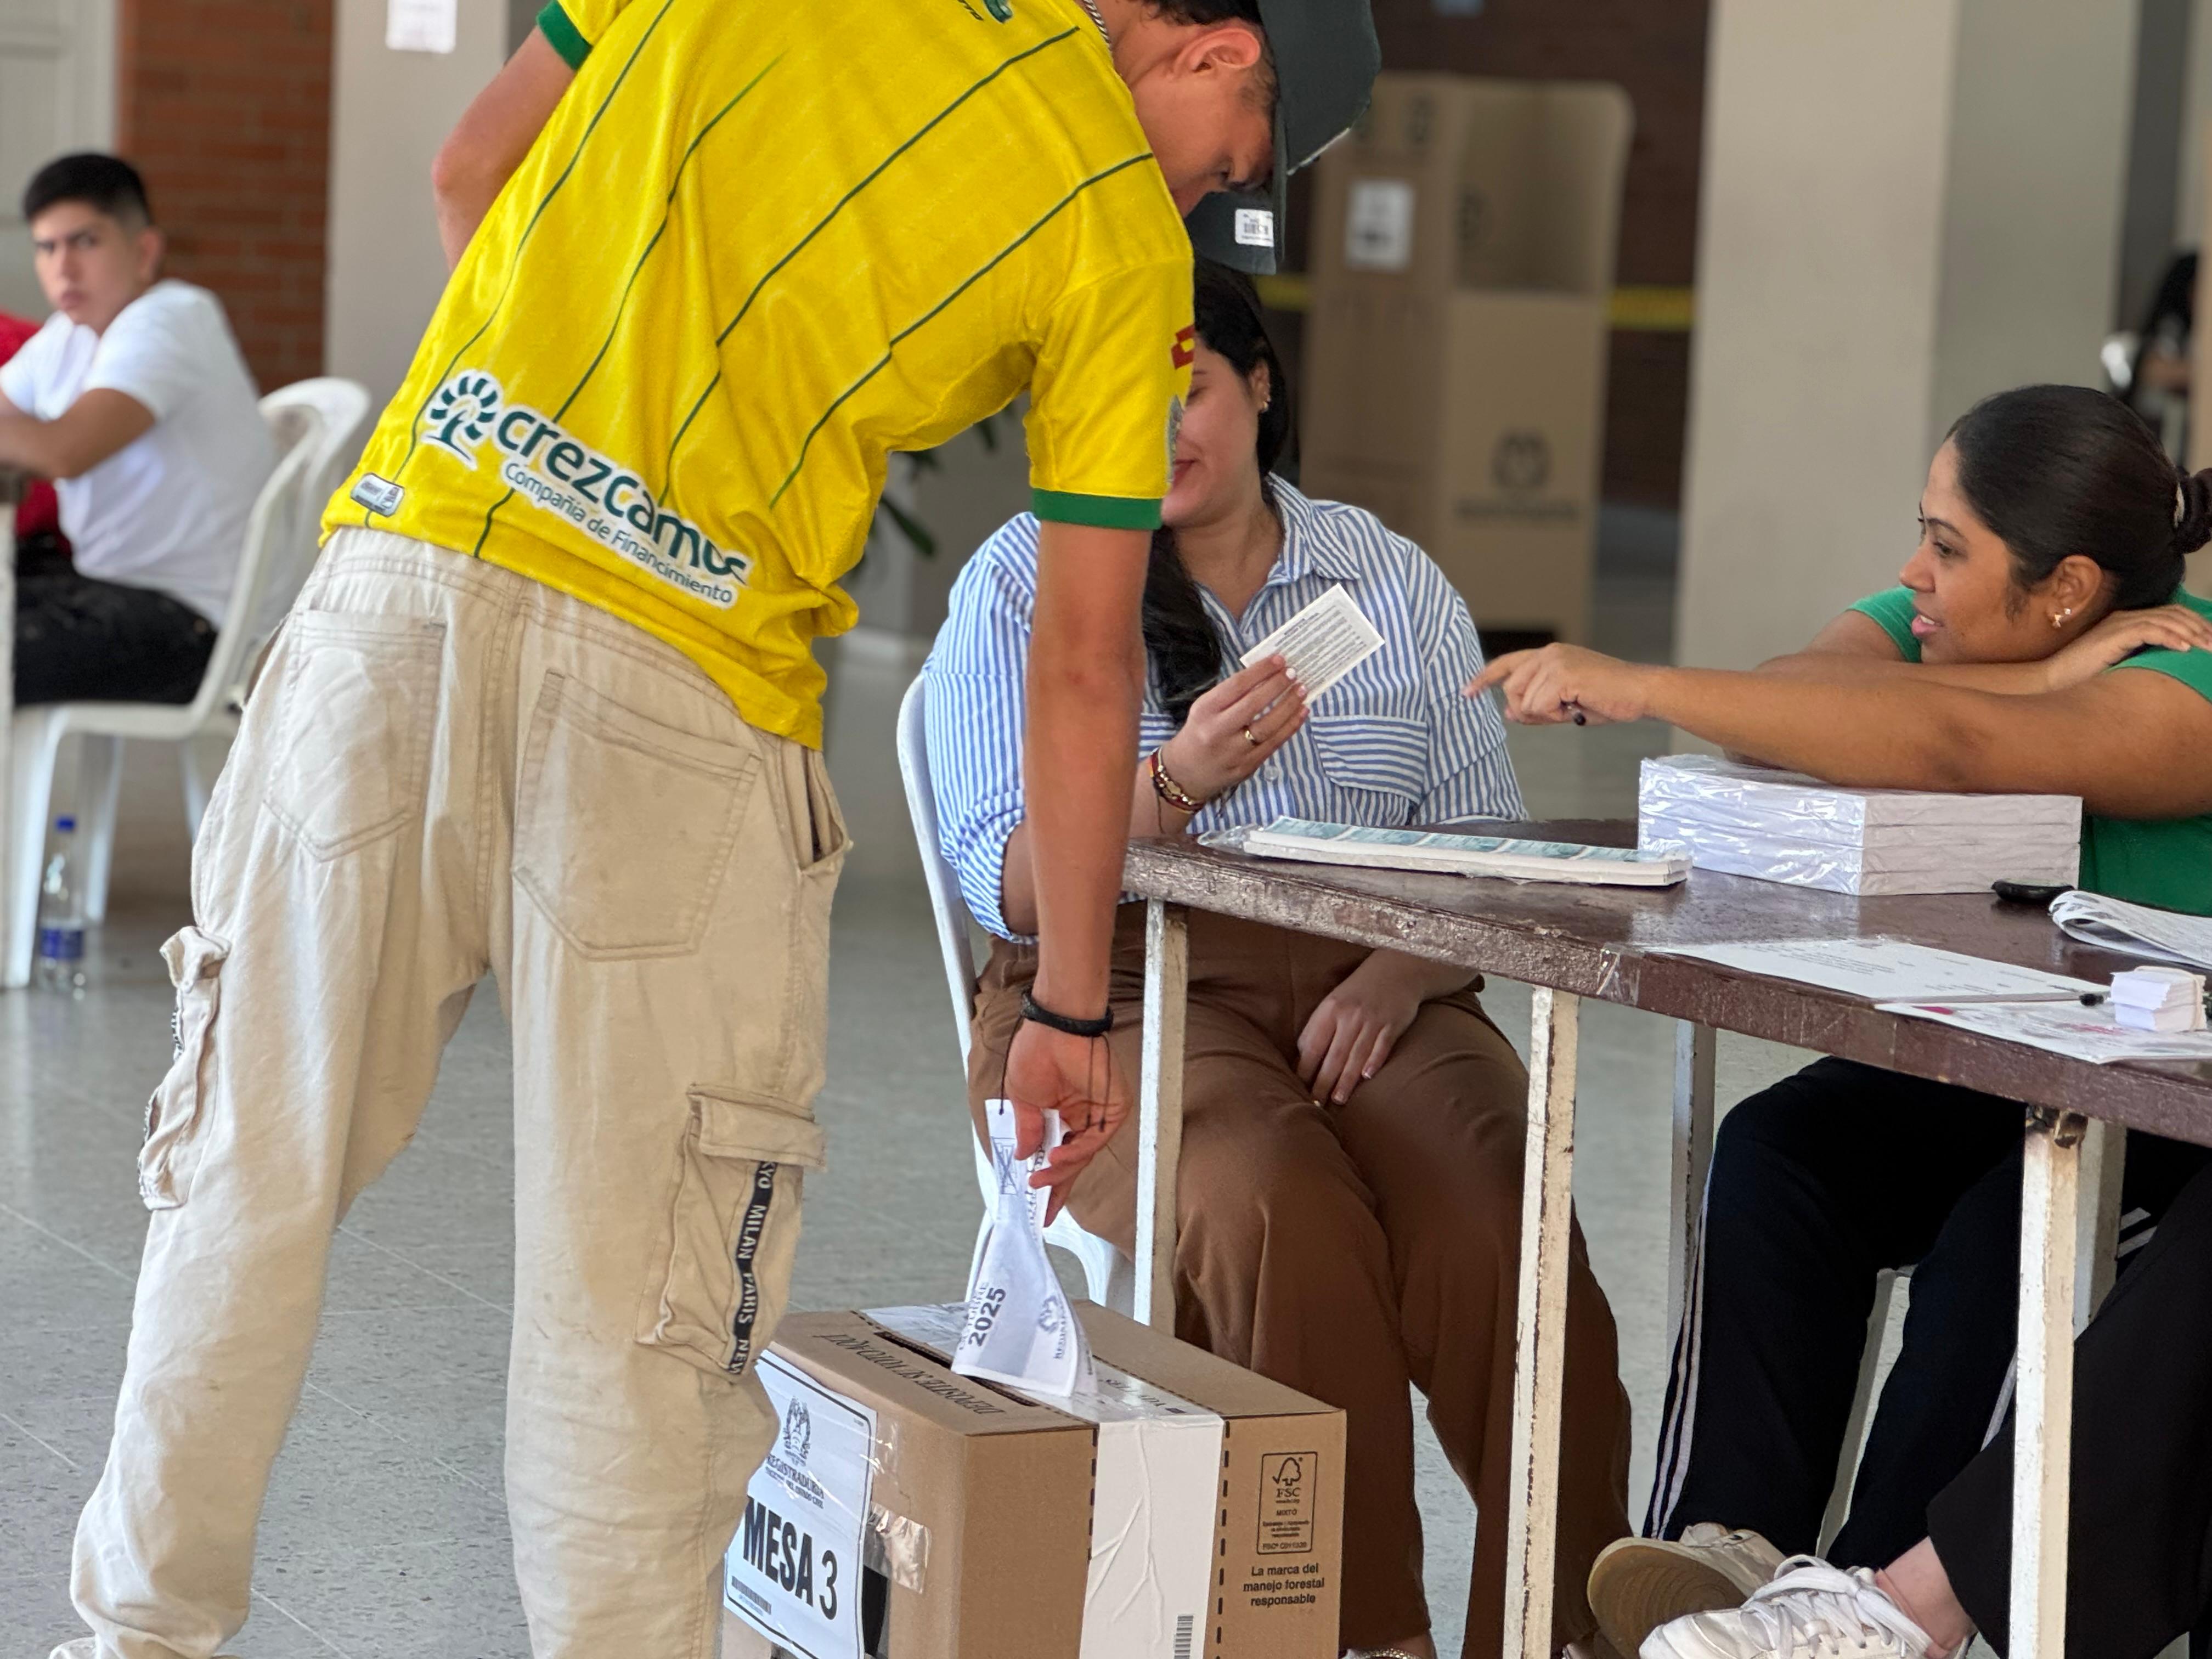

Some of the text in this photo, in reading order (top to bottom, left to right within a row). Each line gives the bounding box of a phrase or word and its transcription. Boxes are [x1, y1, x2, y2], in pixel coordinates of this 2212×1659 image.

[586, 518, 611, 540] de
[737, 1205, 767, 1260] MILAN
[738, 1272, 757, 1324] PARIS
[968, 1287, 1006, 1347] 2025
[1276, 1487, 1302, 1498] FSC
[743, 1494, 838, 1620] MESA 3
[1251, 1562, 1319, 1576] La marca del
[1243, 1577, 1325, 1593] manejo forestal
[1250, 1593, 1316, 1609] responsable
